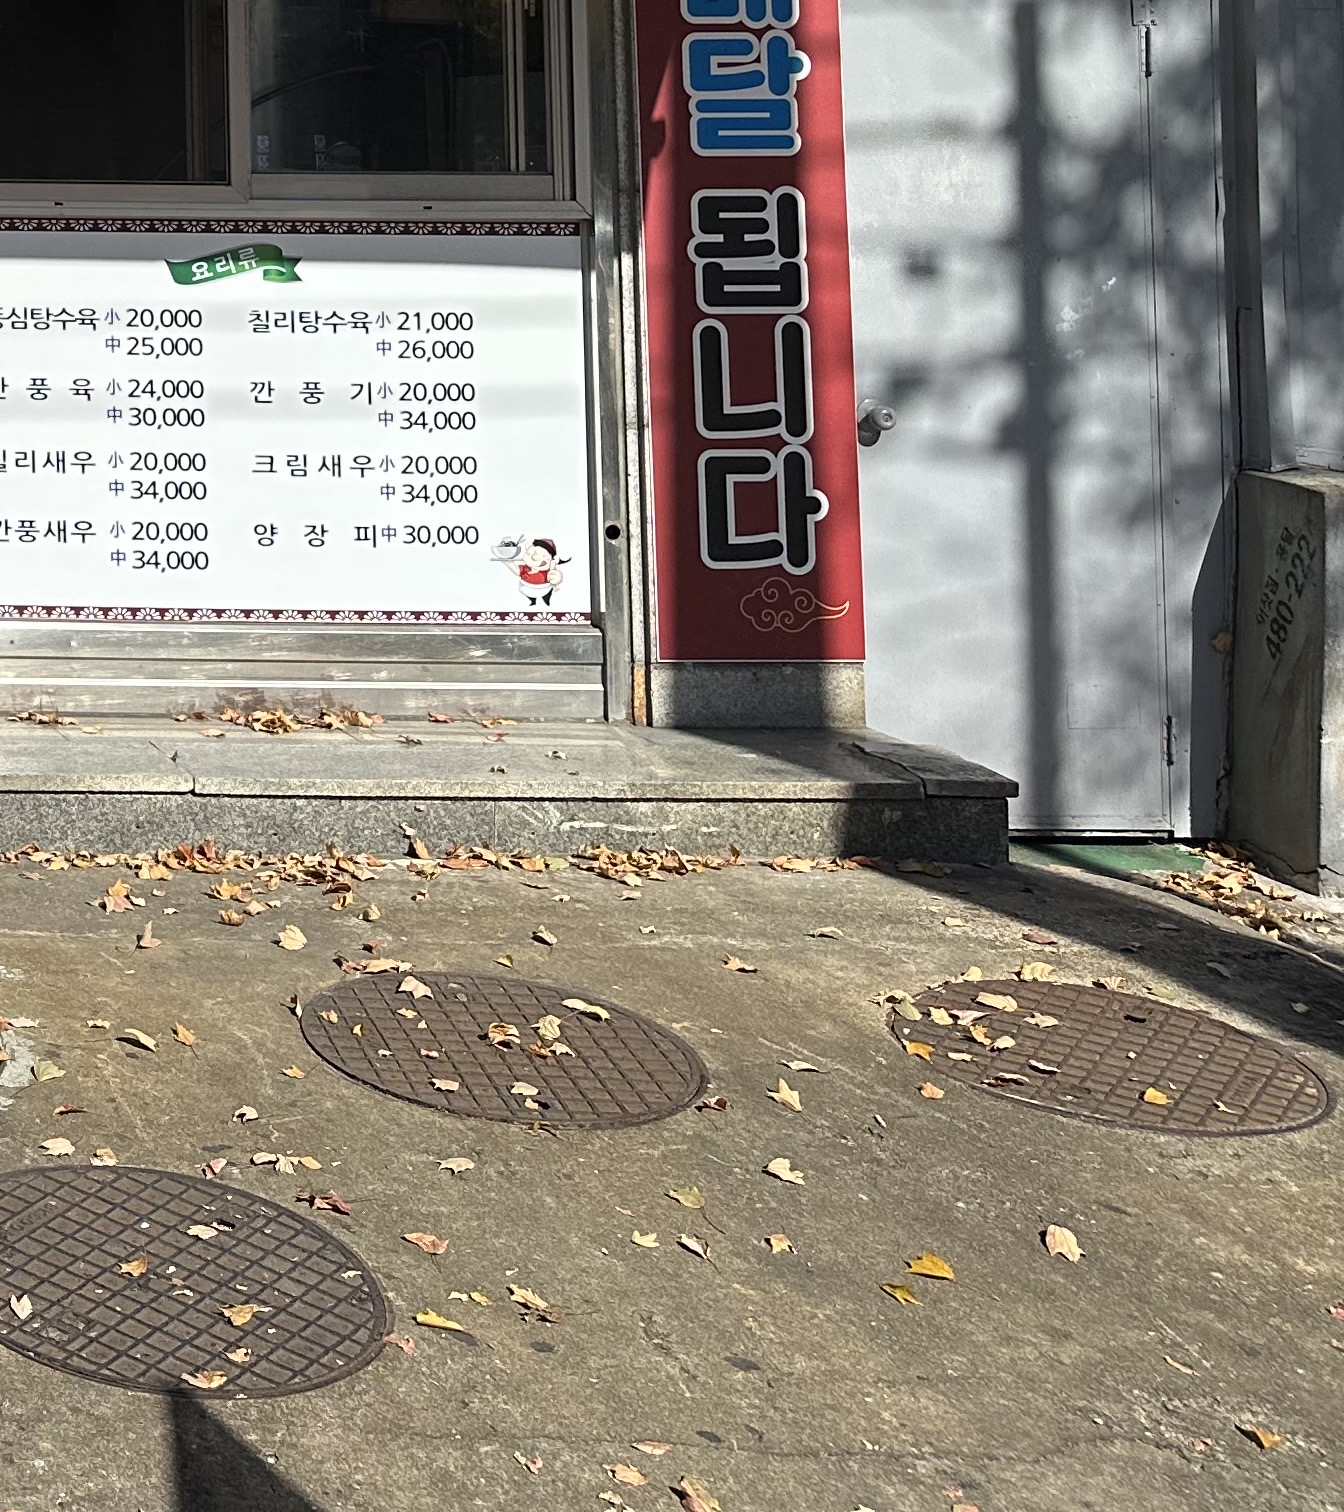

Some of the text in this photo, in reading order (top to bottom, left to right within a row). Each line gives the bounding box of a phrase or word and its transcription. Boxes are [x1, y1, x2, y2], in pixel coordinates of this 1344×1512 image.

[190, 245, 261, 283] 요리류
[125, 308, 203, 332] 20,000
[247, 309, 374, 335] 칠리탕수육
[396, 311, 474, 335] 21,000
[126, 336, 204, 360] 25,000
[397, 339, 475, 363] 26,000
[127, 378, 205, 402] 24,000
[686, 185, 829, 576] 됩니다
[398, 382, 476, 406] 20,000
[128, 406, 206, 430] 30,000
[399, 410, 477, 434] 34,000
[129, 451, 207, 475] 20,000
[251, 453, 376, 479] 크림새우
[400, 455, 478, 479] 20,000
[130, 480, 208, 504] 34,000
[401, 483, 479, 507] 34,000
[131, 521, 209, 545] 20,000
[402, 524, 480, 548] 30,000
[131, 549, 210, 574] 34,000
